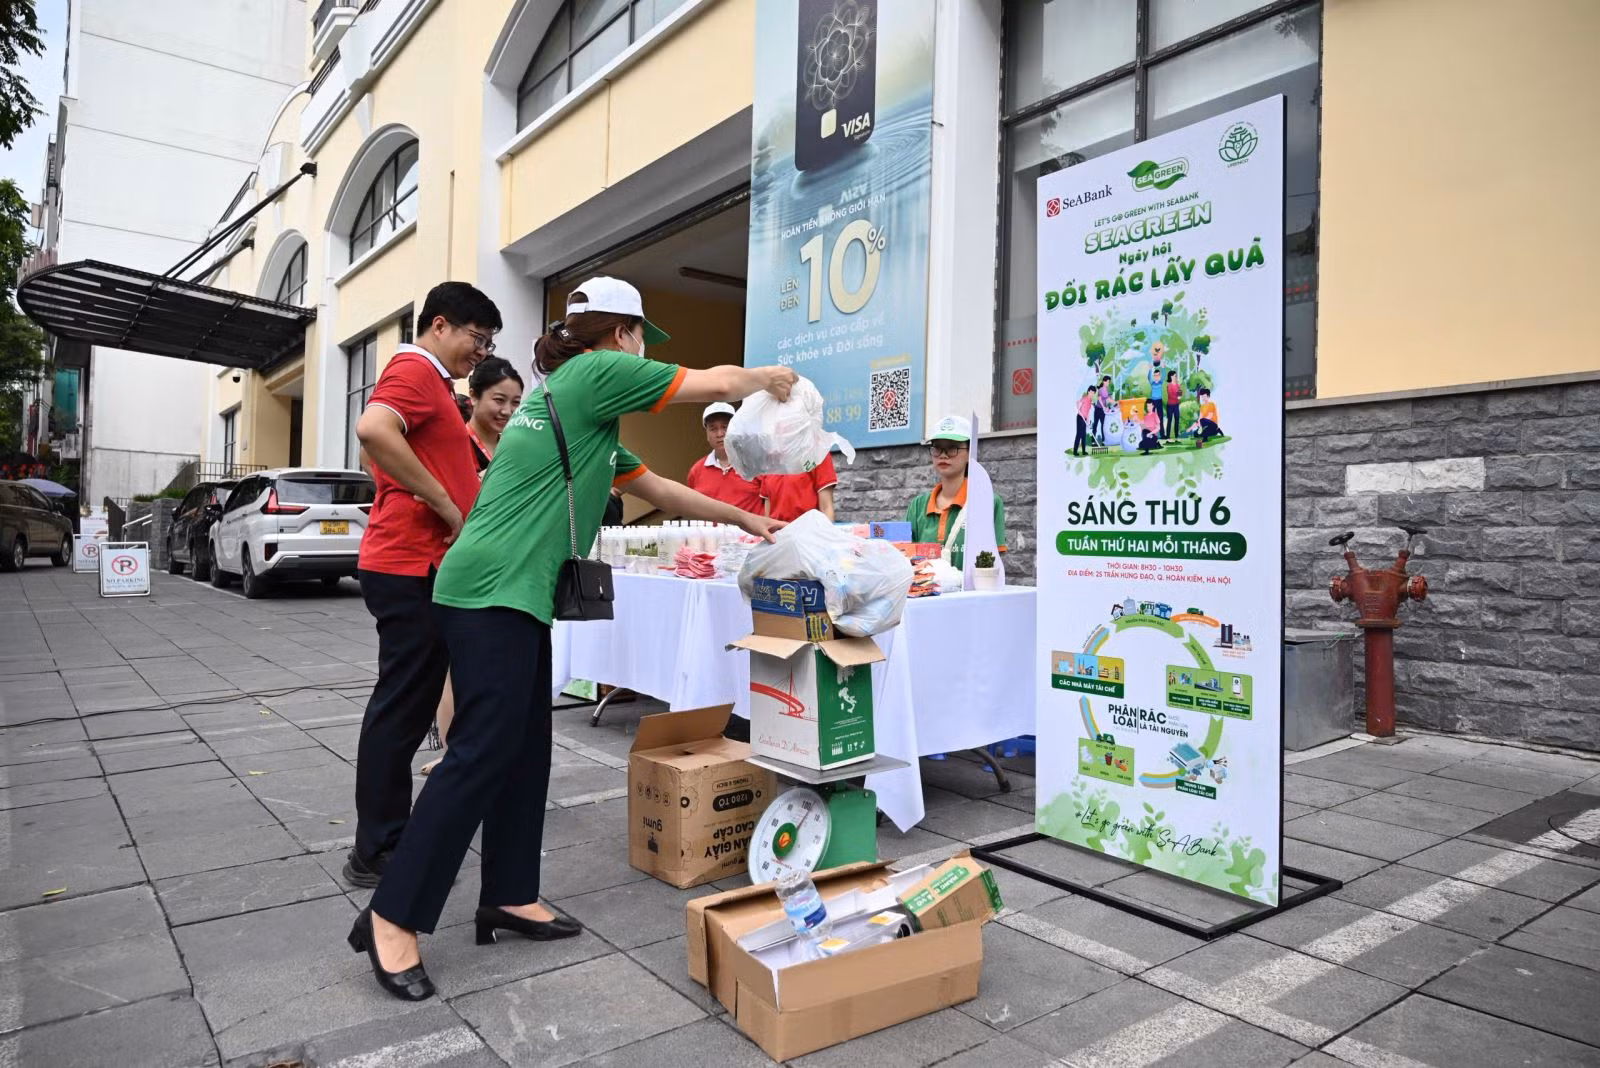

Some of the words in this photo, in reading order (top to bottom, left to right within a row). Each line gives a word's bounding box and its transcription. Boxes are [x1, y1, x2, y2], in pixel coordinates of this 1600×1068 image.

[841, 112, 870, 138] VISA
[1062, 184, 1112, 210] SeABank
[1094, 216, 1110, 228] LET'S
[1112, 213, 1124, 222] GO
[1124, 207, 1146, 220] GREEN
[1148, 202, 1165, 214] WITH
[1166, 192, 1199, 208] SEABANK
[1084, 201, 1212, 254] SEAGREEN
[1119, 249, 1148, 266] Ngày
[1152, 242, 1172, 258] hội
[1095, 268, 1144, 301] RÁC
[1151, 256, 1196, 288] LẤY
[830, 325, 848, 336] cao
[826, 408, 842, 423] 88
[845, 405, 862, 421] 99
[1067, 495, 1138, 526] SÁNG
[1209, 496, 1232, 526] 6
[1101, 537, 1126, 552] THỨ
[1128, 540, 1148, 552] HAI
[1152, 534, 1178, 554] MỖI
[1182, 538, 1231, 554] THÁNG
[1108, 704, 1136, 718] PHÂN
[1140, 708, 1167, 724] RÁC
[1113, 715, 1136, 728] LOẠI
[1161, 726, 1188, 738] NGUYÊN
[802, 800, 812, 810] 100
[643, 816, 663, 832] gumi
[735, 821, 754, 833] CAO
[1100, 819, 1110, 832] go
[1113, 822, 1134, 836] green
[1136, 823, 1154, 838] with
